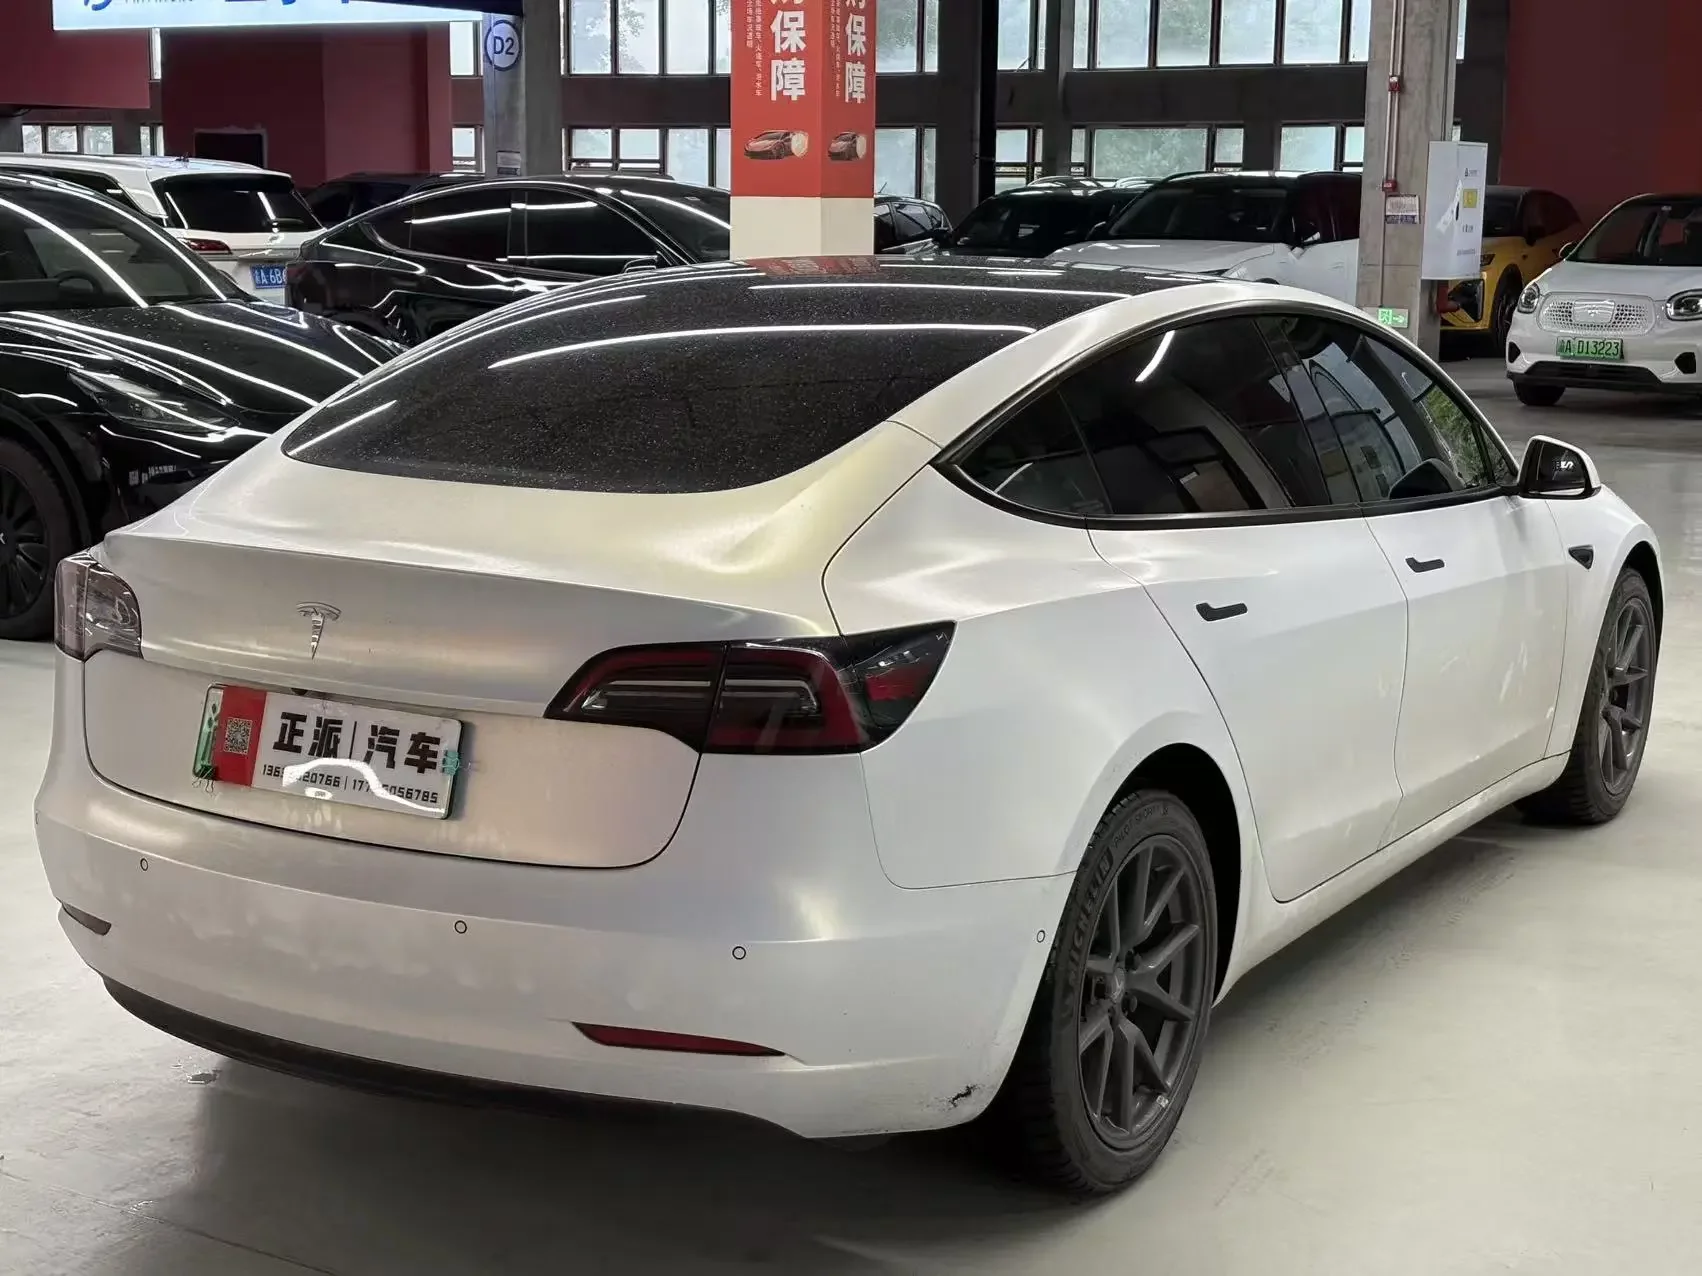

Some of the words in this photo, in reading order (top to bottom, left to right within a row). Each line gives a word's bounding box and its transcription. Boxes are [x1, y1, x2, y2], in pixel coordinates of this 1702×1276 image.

[493, 36, 515, 56] D2
[770, 0, 807, 101] 保障
[845, 0, 867, 104] 保障
[273, 712, 343, 758] 正派
[363, 724, 441, 774] 汽车
[262, 764, 341, 788] 13620766
[353, 779, 438, 803] 177056785
